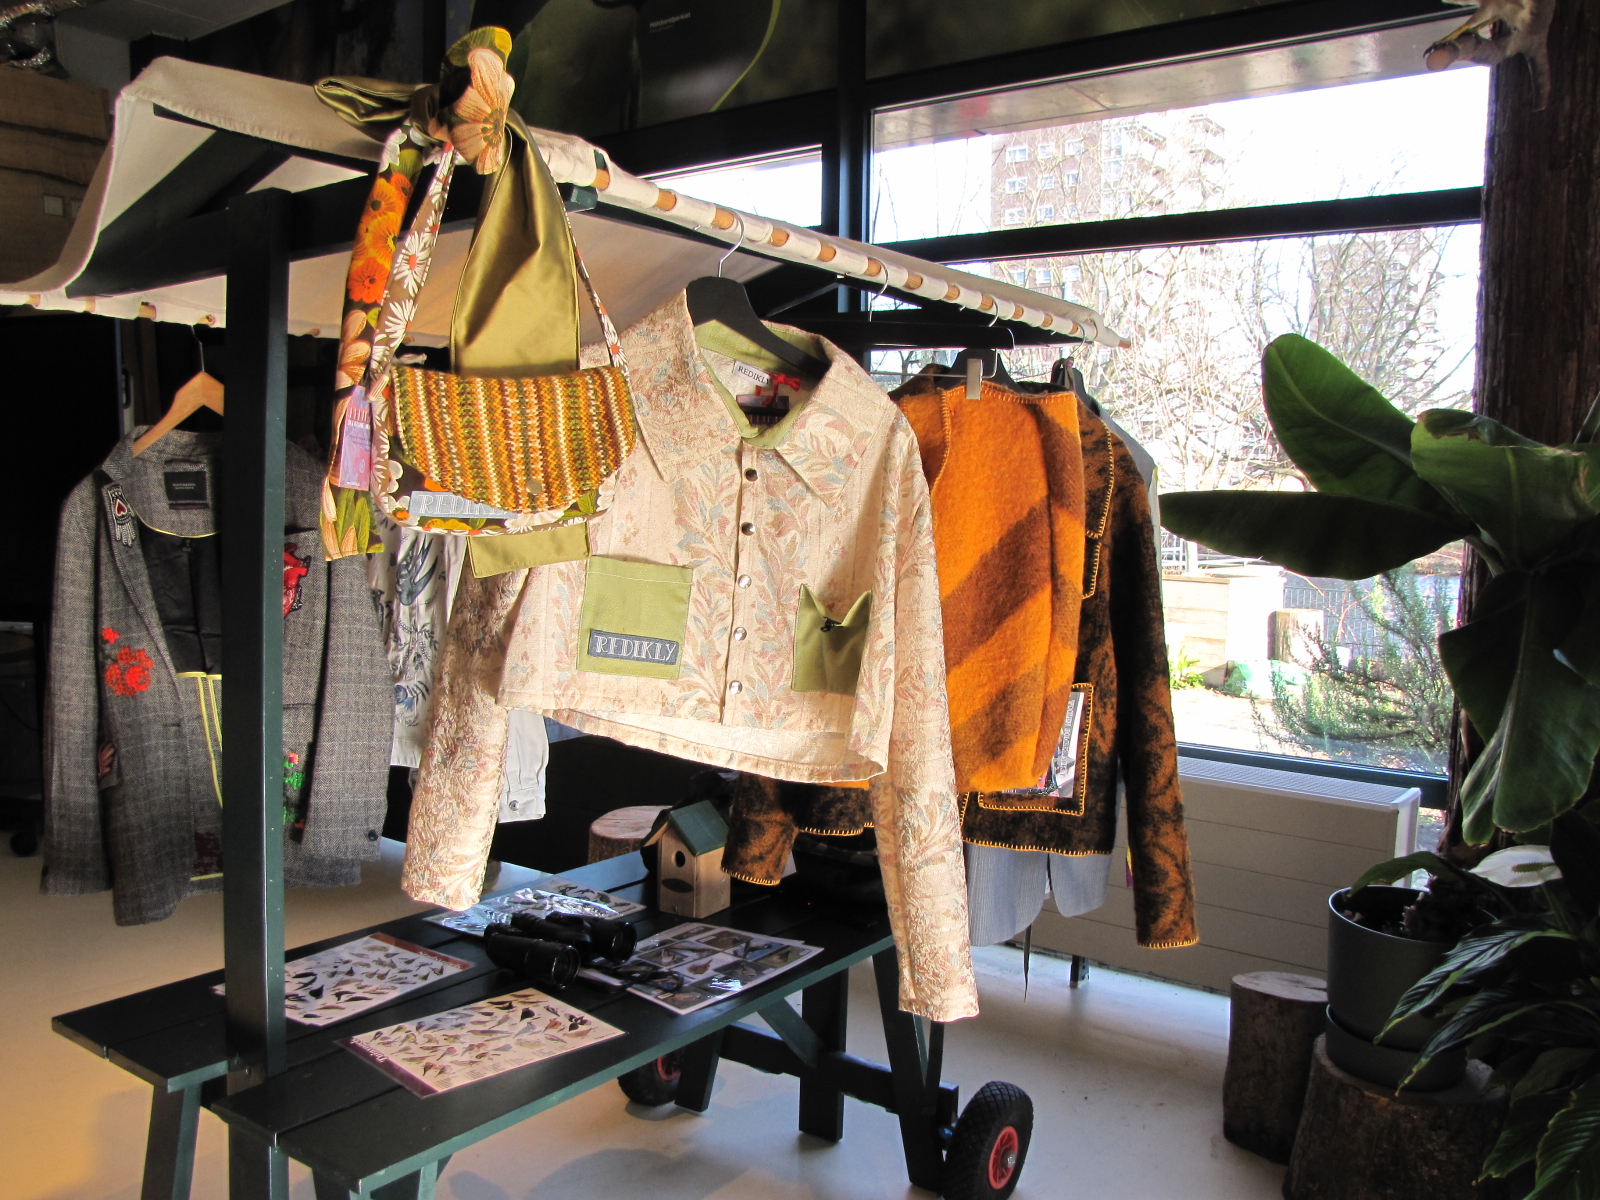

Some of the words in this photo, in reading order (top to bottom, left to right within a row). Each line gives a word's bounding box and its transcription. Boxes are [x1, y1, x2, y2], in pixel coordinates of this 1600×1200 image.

[737, 365, 770, 385] REDIKLY
[418, 494, 507, 515] REDIK
[594, 634, 677, 661] REDIKLY
